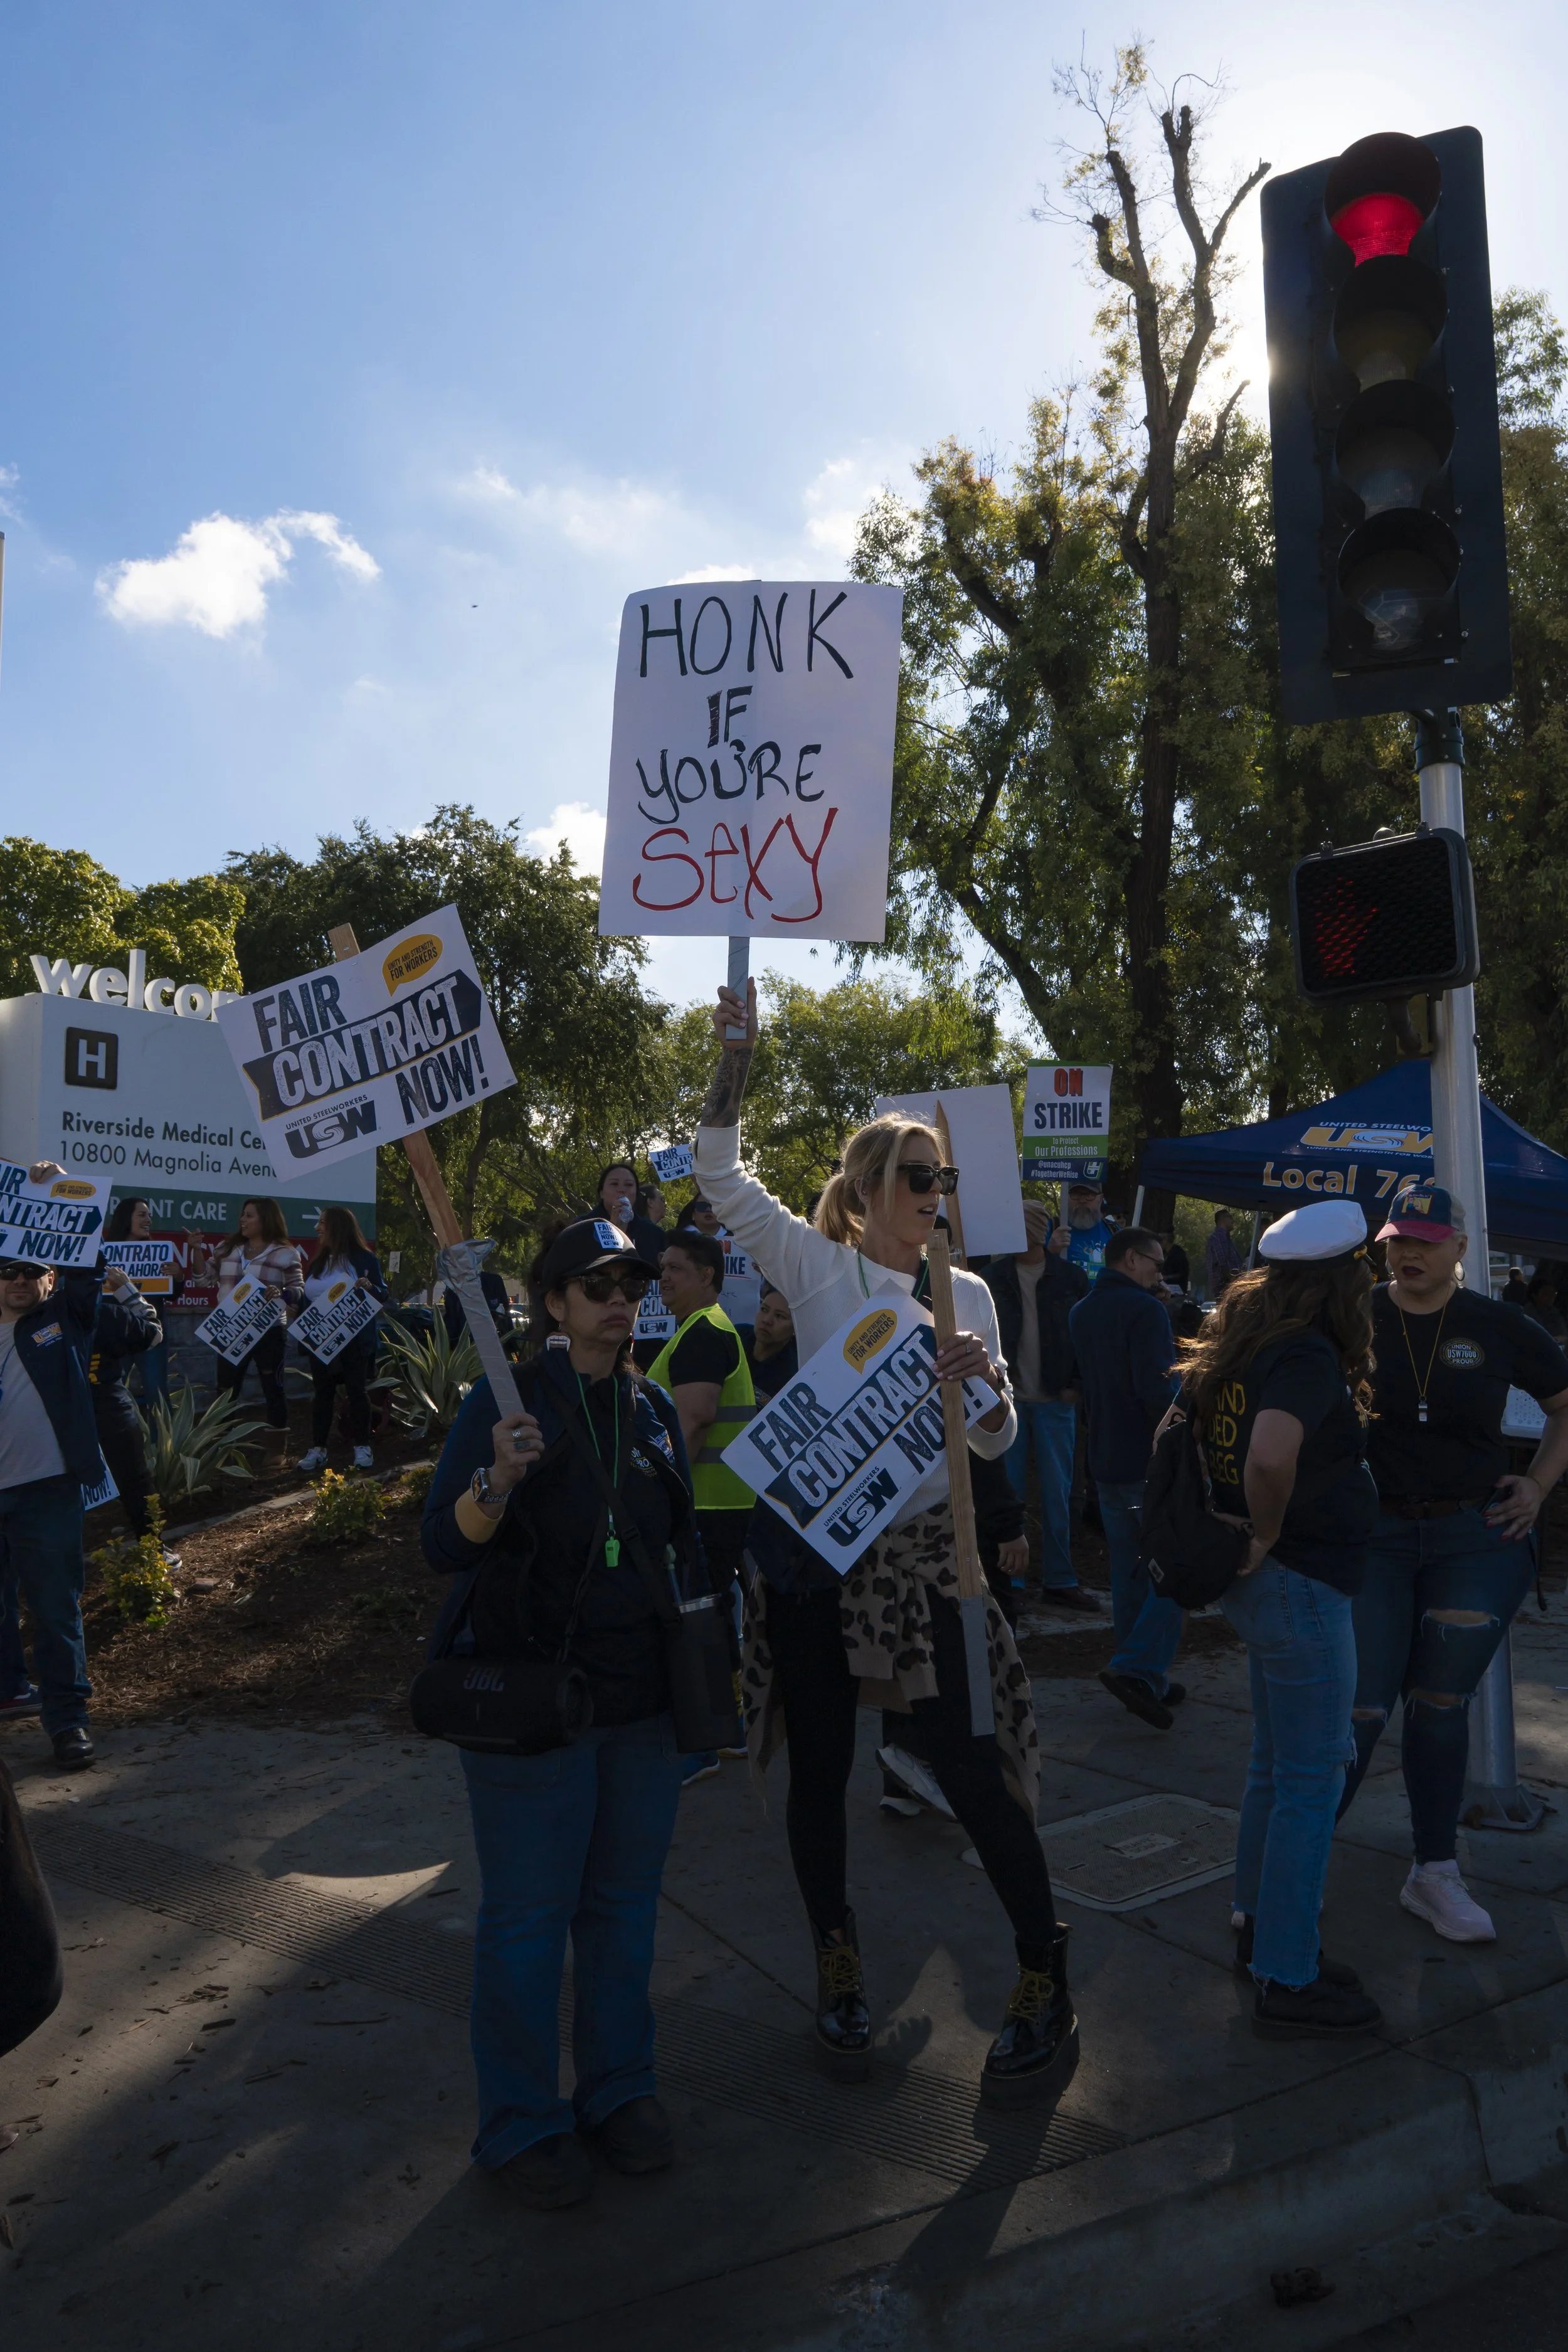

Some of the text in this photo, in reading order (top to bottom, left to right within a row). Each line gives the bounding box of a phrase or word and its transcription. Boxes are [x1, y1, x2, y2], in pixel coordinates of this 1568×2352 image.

[639, 588, 854, 679] HONK
[706, 685, 753, 749] IF
[635, 738, 825, 825] YOU'RE
[387, 940, 434, 970] UNITY AND STRENGTH
[389, 946, 438, 981] FOR WORKERS
[252, 975, 347, 1054] FAIR
[273, 976, 463, 1107] CONTRACT
[78, 1039, 107, 1079] H
[395, 1034, 490, 1126] NOW!
[1054, 1067, 1084, 1097] ON
[285, 1094, 368, 1130] UNITED STEELWORKERS
[1034, 1101, 1103, 1130] STRIKE
[1370, 1123, 1433, 1133] STEELWO
[61, 1111, 155, 1140] Riverside
[162, 1121, 233, 1147] Medical
[284, 1099, 377, 1159] USW
[1059, 1136, 1079, 1145] Protect
[61, 1140, 126, 1165] 10800
[134, 1148, 221, 1175] Magnolia
[657, 1148, 678, 1161] FAIR
[660, 1154, 693, 1170] CONTR
[1035, 1145, 1098, 1157] Our Professions
[1038, 1160, 1071, 1170] @unacuhcp
[0, 1163, 27, 1195] IR
[663, 1168, 685, 1179] USW
[1030, 1169, 1079, 1179] #TogetherWeRise
[1262, 1162, 1359, 1195] Local
[0, 1194, 94, 1234] NTRACT
[180, 1199, 227, 1221] CARE
[597, 1224, 613, 1232] FAIR
[18, 1230, 87, 1263] NOW!
[103, 1244, 169, 1263] ONTRATO
[725, 1256, 746, 1275] IKE
[203, 1308, 231, 1337] FAIR
[216, 1289, 268, 1348] CONTRACT
[251, 1300, 282, 1334] NOW!
[296, 1306, 324, 1335] FAIR
[309, 1288, 362, 1346] CONTRACT
[344, 1300, 375, 1335] NOW!
[640, 1296, 672, 1316] CON
[322, 1332, 346, 1357] USW
[639, 1322, 668, 1334] USW
[847, 1312, 887, 1355] UNITY AND STRENGTH
[852, 1316, 895, 1362] FOR WORKERS
[230, 1333, 255, 1358] USW
[1447, 1349, 1477, 1359] USW7600
[748, 1382, 833, 1473] FAIR
[788, 1331, 940, 1508] CONTRACT
[823, 1466, 880, 1527] UNITED STEELWORKERS
[825, 1467, 899, 1547] USW
[464, 1665, 505, 1692] JBL
